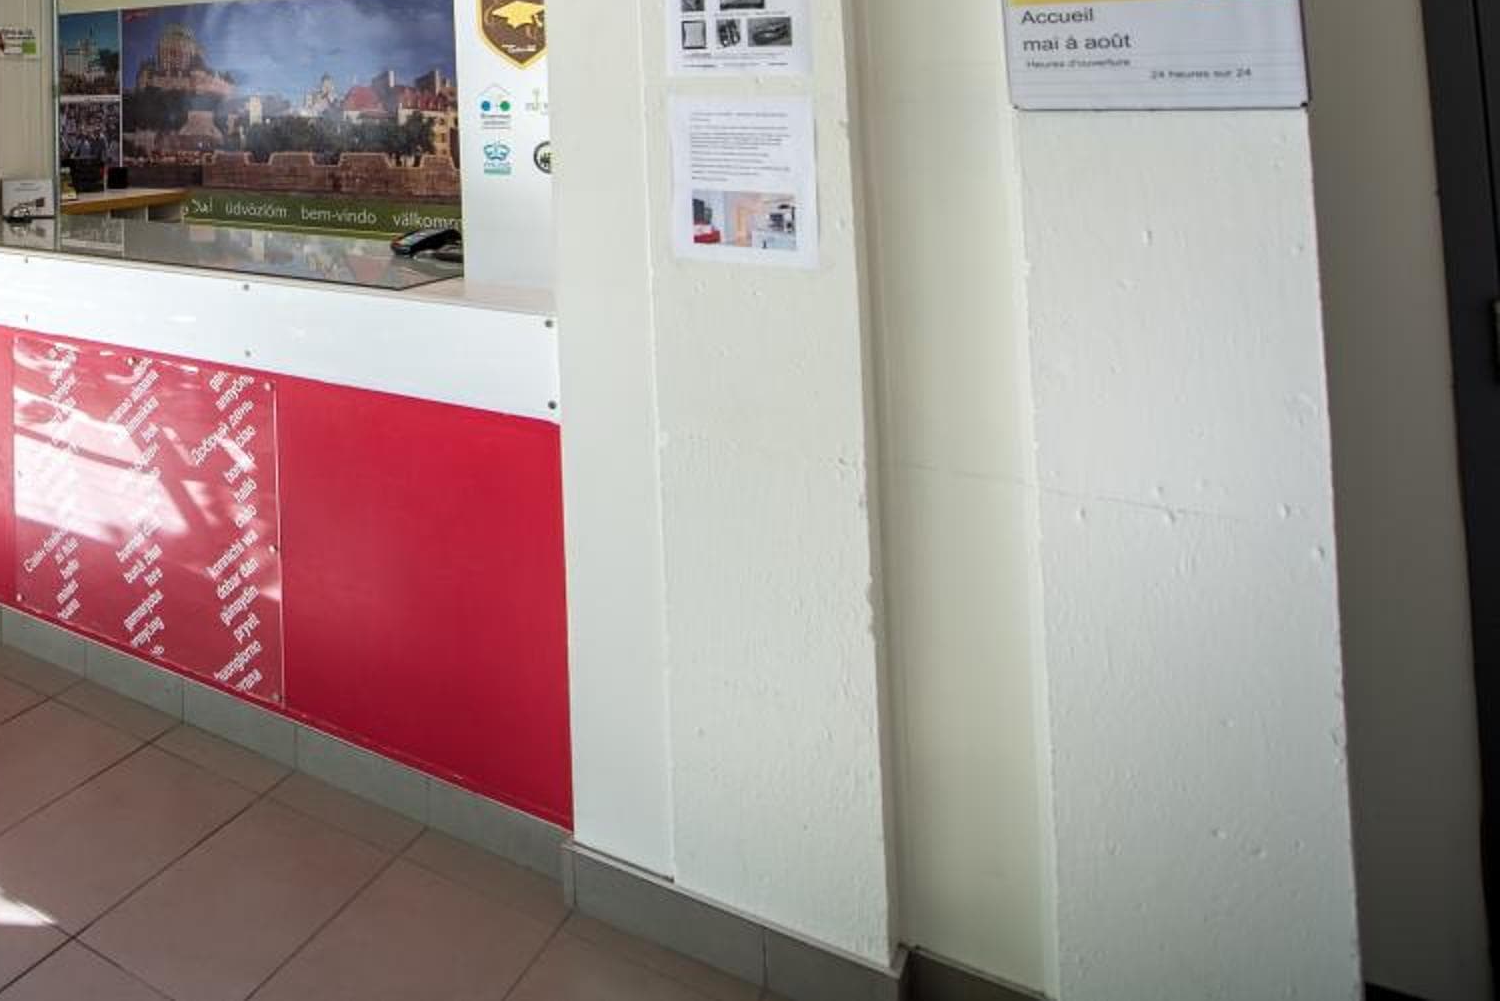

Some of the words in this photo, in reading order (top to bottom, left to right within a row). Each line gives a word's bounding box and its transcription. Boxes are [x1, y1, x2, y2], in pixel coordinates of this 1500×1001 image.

[1021, 7, 1093, 24] Accueil
[1023, 38, 1059, 51] mai
[1065, 34, 1078, 50] à
[1084, 33, 1132, 50] août
[300, 206, 377, 224] bem-vindo
